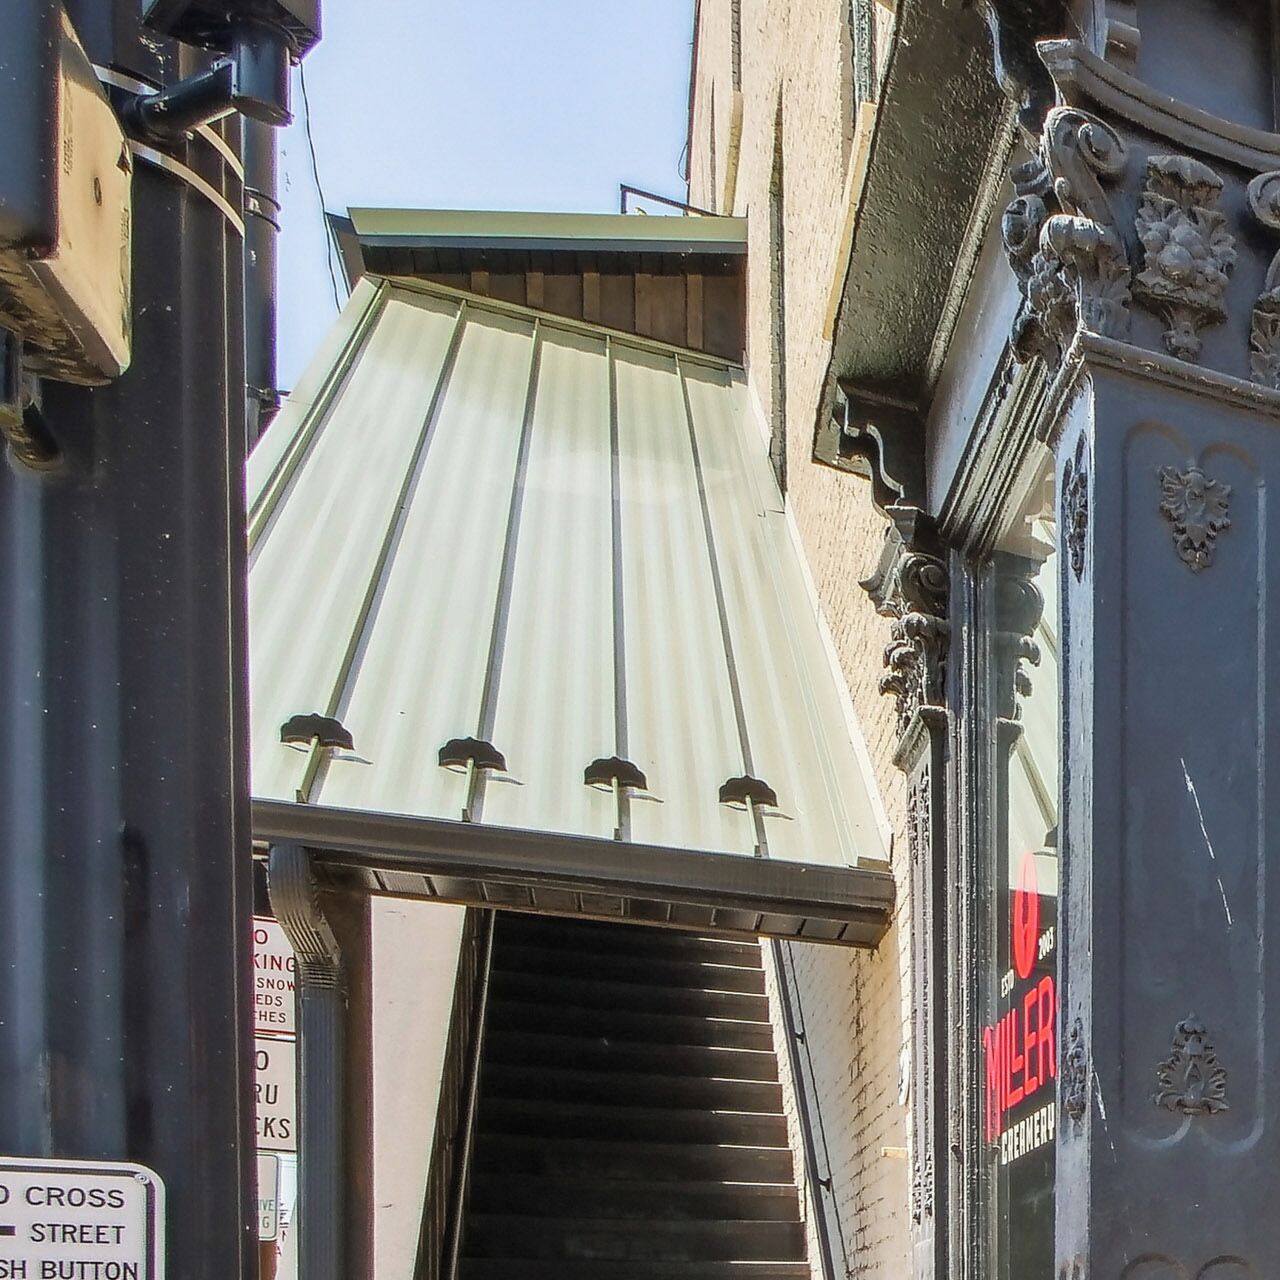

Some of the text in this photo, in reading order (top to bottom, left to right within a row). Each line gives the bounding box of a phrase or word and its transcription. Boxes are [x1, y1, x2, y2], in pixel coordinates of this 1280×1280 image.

[254, 928, 269, 945] O
[255, 1050, 270, 1071] O
[983, 975, 1058, 1143] MILLER
[1001, 1102, 1056, 1166] CREAMERY
[25, 1186, 125, 1208] CROSS
[30, 1223, 126, 1244] STREET
[0, 1259, 139, 1280] SH BUTTON
